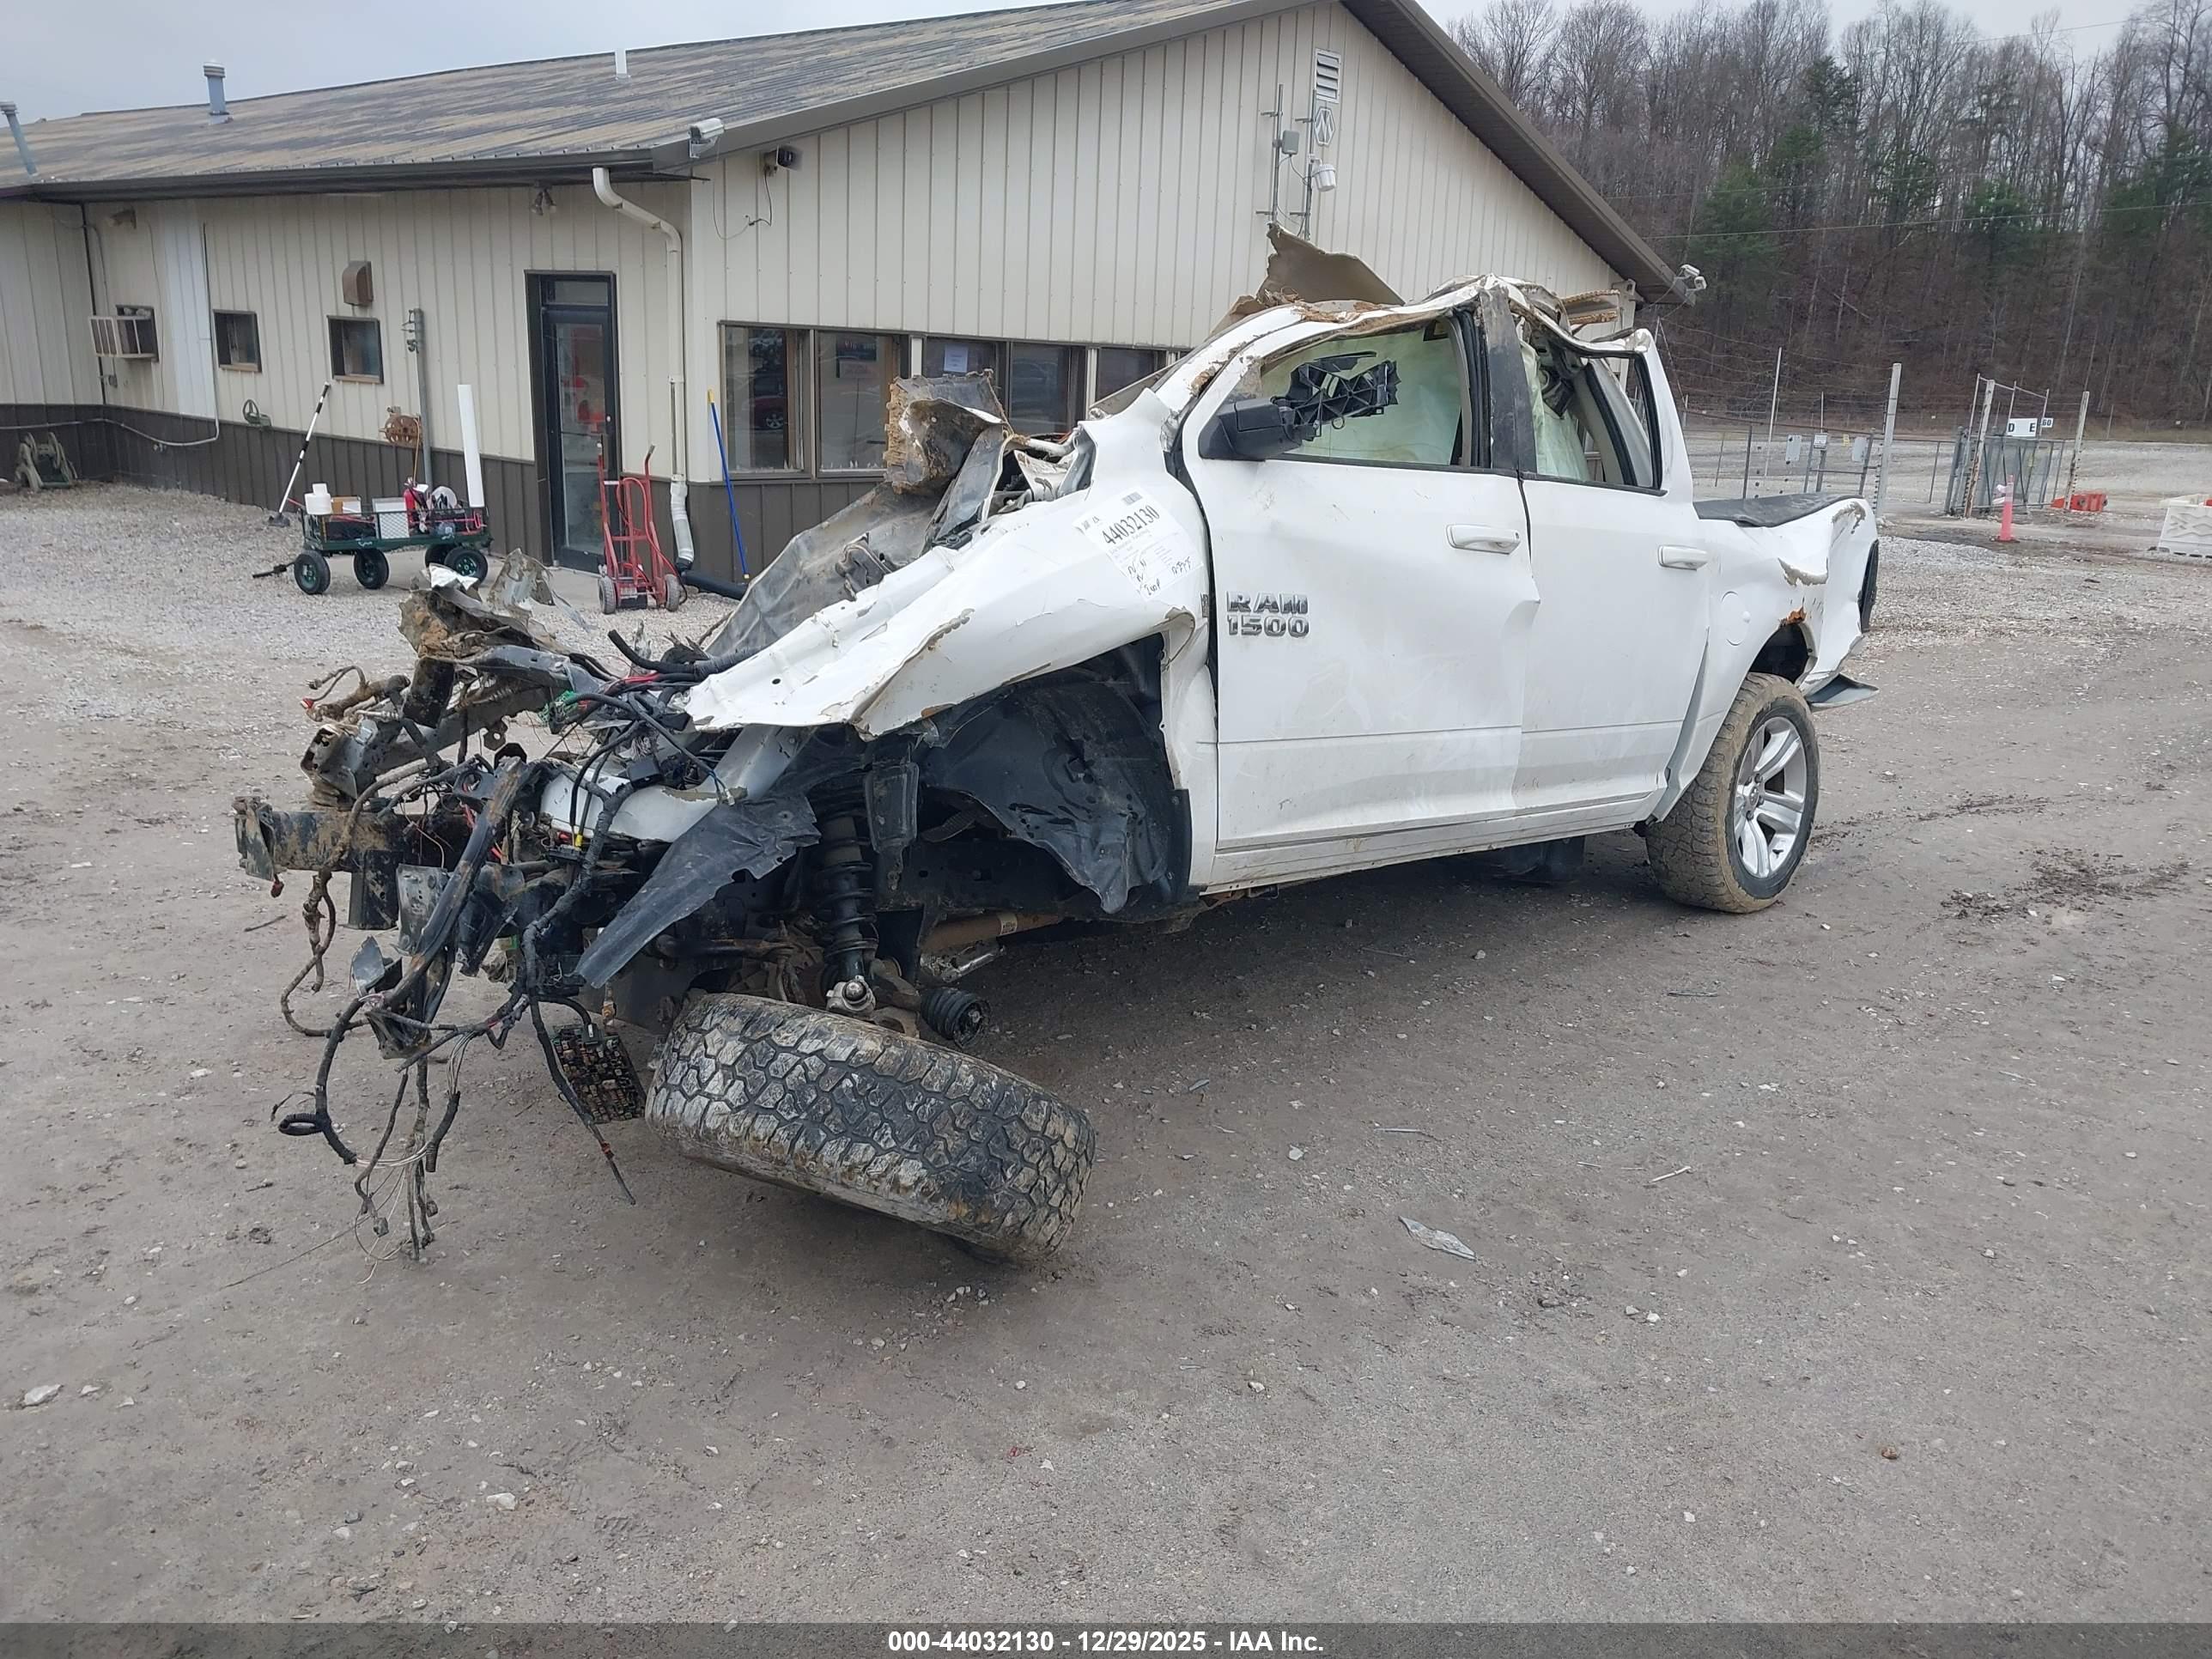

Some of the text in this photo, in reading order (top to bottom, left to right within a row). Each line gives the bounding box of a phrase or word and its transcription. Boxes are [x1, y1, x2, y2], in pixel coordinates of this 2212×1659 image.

[1102, 504, 1160, 544] 44032130
[1227, 591, 1309, 615] RAM
[1227, 615, 1310, 638] 1500
